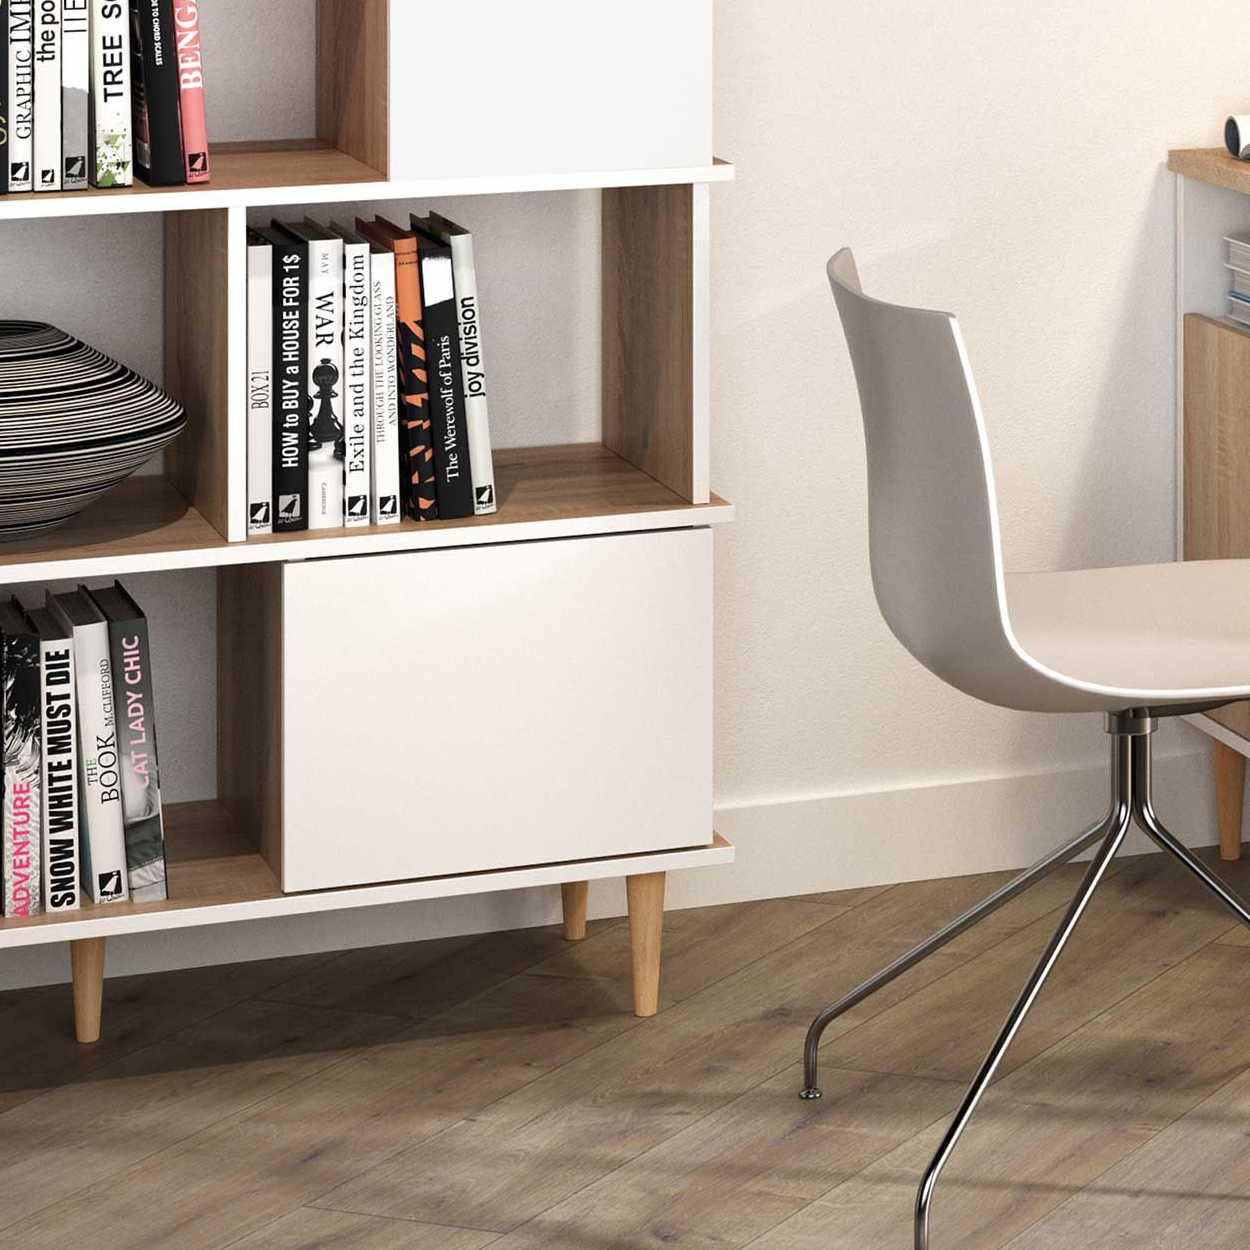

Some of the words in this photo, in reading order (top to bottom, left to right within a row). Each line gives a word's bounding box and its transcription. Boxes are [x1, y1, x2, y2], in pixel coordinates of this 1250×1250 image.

[152, 8, 159, 17] TO
[153, 18, 161, 41] CHORD
[37, 28, 55, 62] the
[154, 42, 163, 65] SCALES
[102, 35, 123, 102] TREE
[16, 50, 31, 139] GRAPHIC
[283, 254, 301, 272] 1$
[320, 252, 329, 275] MAY
[282, 276, 300, 307] FOR
[349, 254, 368, 340] Kingdom
[373, 281, 382, 315] GLASS
[282, 310, 299, 362] HOUSE
[315, 291, 335, 348] WAR
[385, 296, 396, 373] WONDERLAND
[457, 296, 480, 367] division
[373, 317, 383, 366] LOOKING
[439, 335, 450, 368] Paris
[286, 365, 299, 376] a
[350, 347, 365, 377] the
[374, 368, 384, 389] THE
[442, 371, 454, 385] of
[251, 384, 269, 410] BOX
[282, 379, 298, 409] BUY
[350, 383, 365, 417] and
[387, 376, 396, 400] INTO
[464, 371, 486, 398] joy
[282, 413, 298, 428] to
[374, 392, 385, 445] THROUGH
[388, 402, 396, 426] AND
[443, 388, 458, 451] Werewolf
[282, 432, 299, 468] HOW
[350, 423, 365, 473] Exile
[447, 453, 459, 483] The
[45, 648, 70, 685] DIE
[121, 635, 142, 684] CHIC
[47, 690, 72, 755] MUST
[126, 690, 147, 745] LADY
[87, 758, 98, 786] THE
[96, 731, 119, 804] BOOK
[128, 750, 149, 789] CAT
[48, 759, 73, 833] WHITE
[13, 781, 31, 917] ADVENTURE
[50, 838, 75, 908] SNOW
